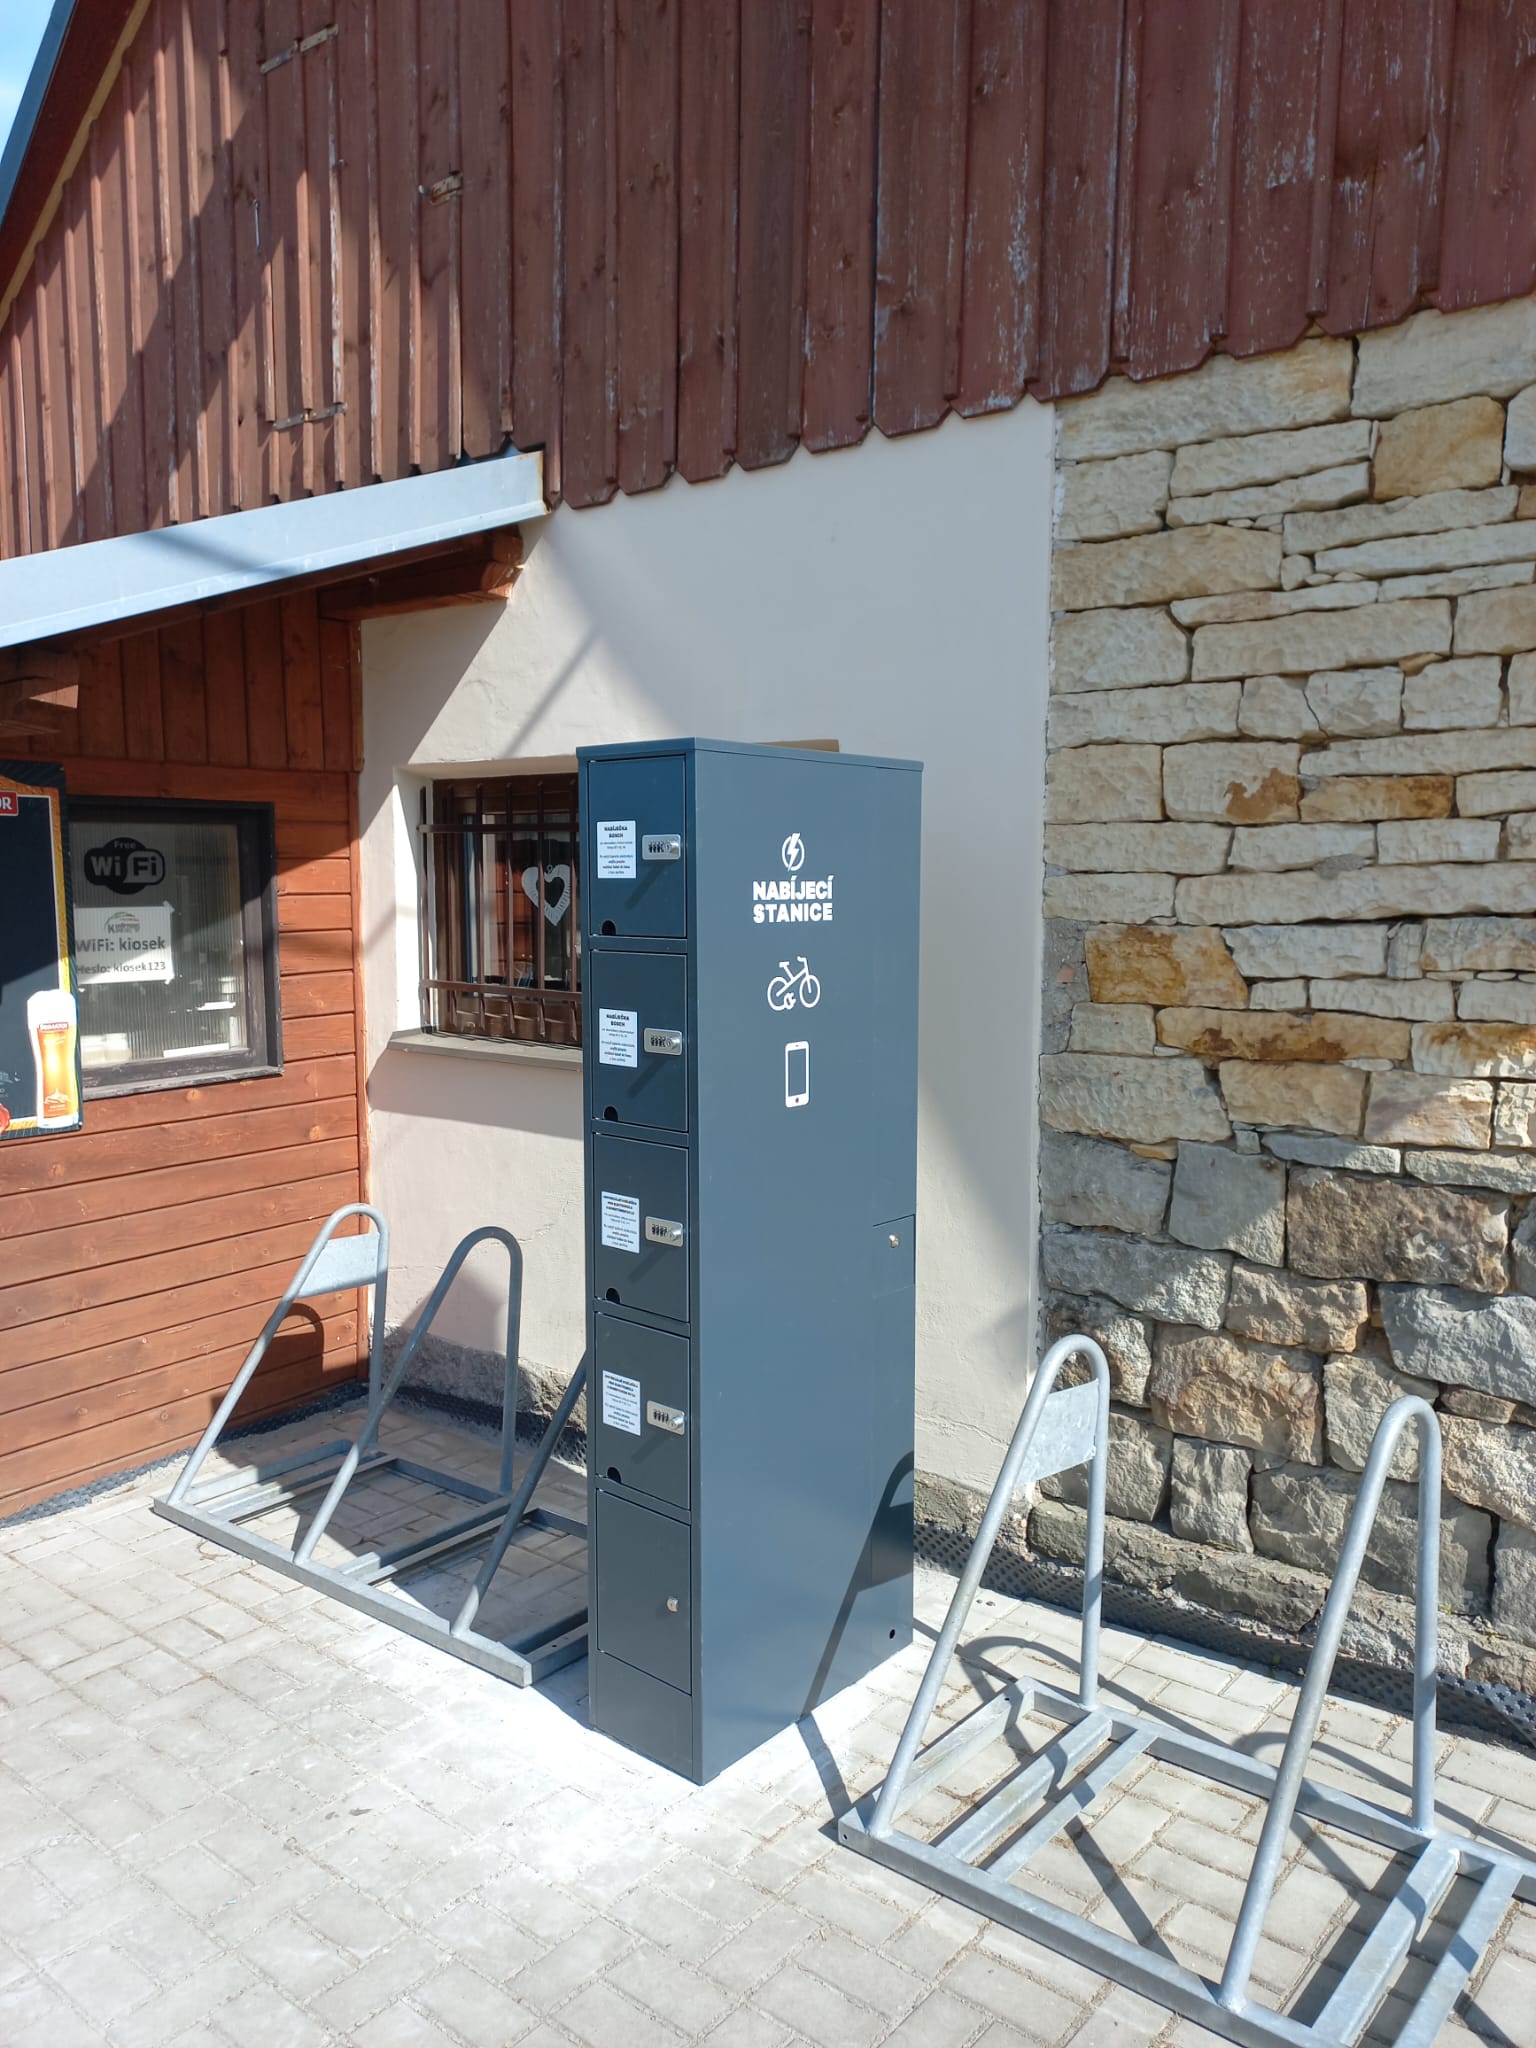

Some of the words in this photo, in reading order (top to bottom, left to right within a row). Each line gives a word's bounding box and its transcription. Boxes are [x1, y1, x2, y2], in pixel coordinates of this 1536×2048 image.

[113, 841, 137, 849] Free
[752, 875, 834, 901] NABÍJECÍ
[752, 902, 833, 924] STANICE
[76, 938, 116, 953] WiFi:
[119, 936, 166, 951] kiosek
[113, 961, 166, 972] kiosek123
